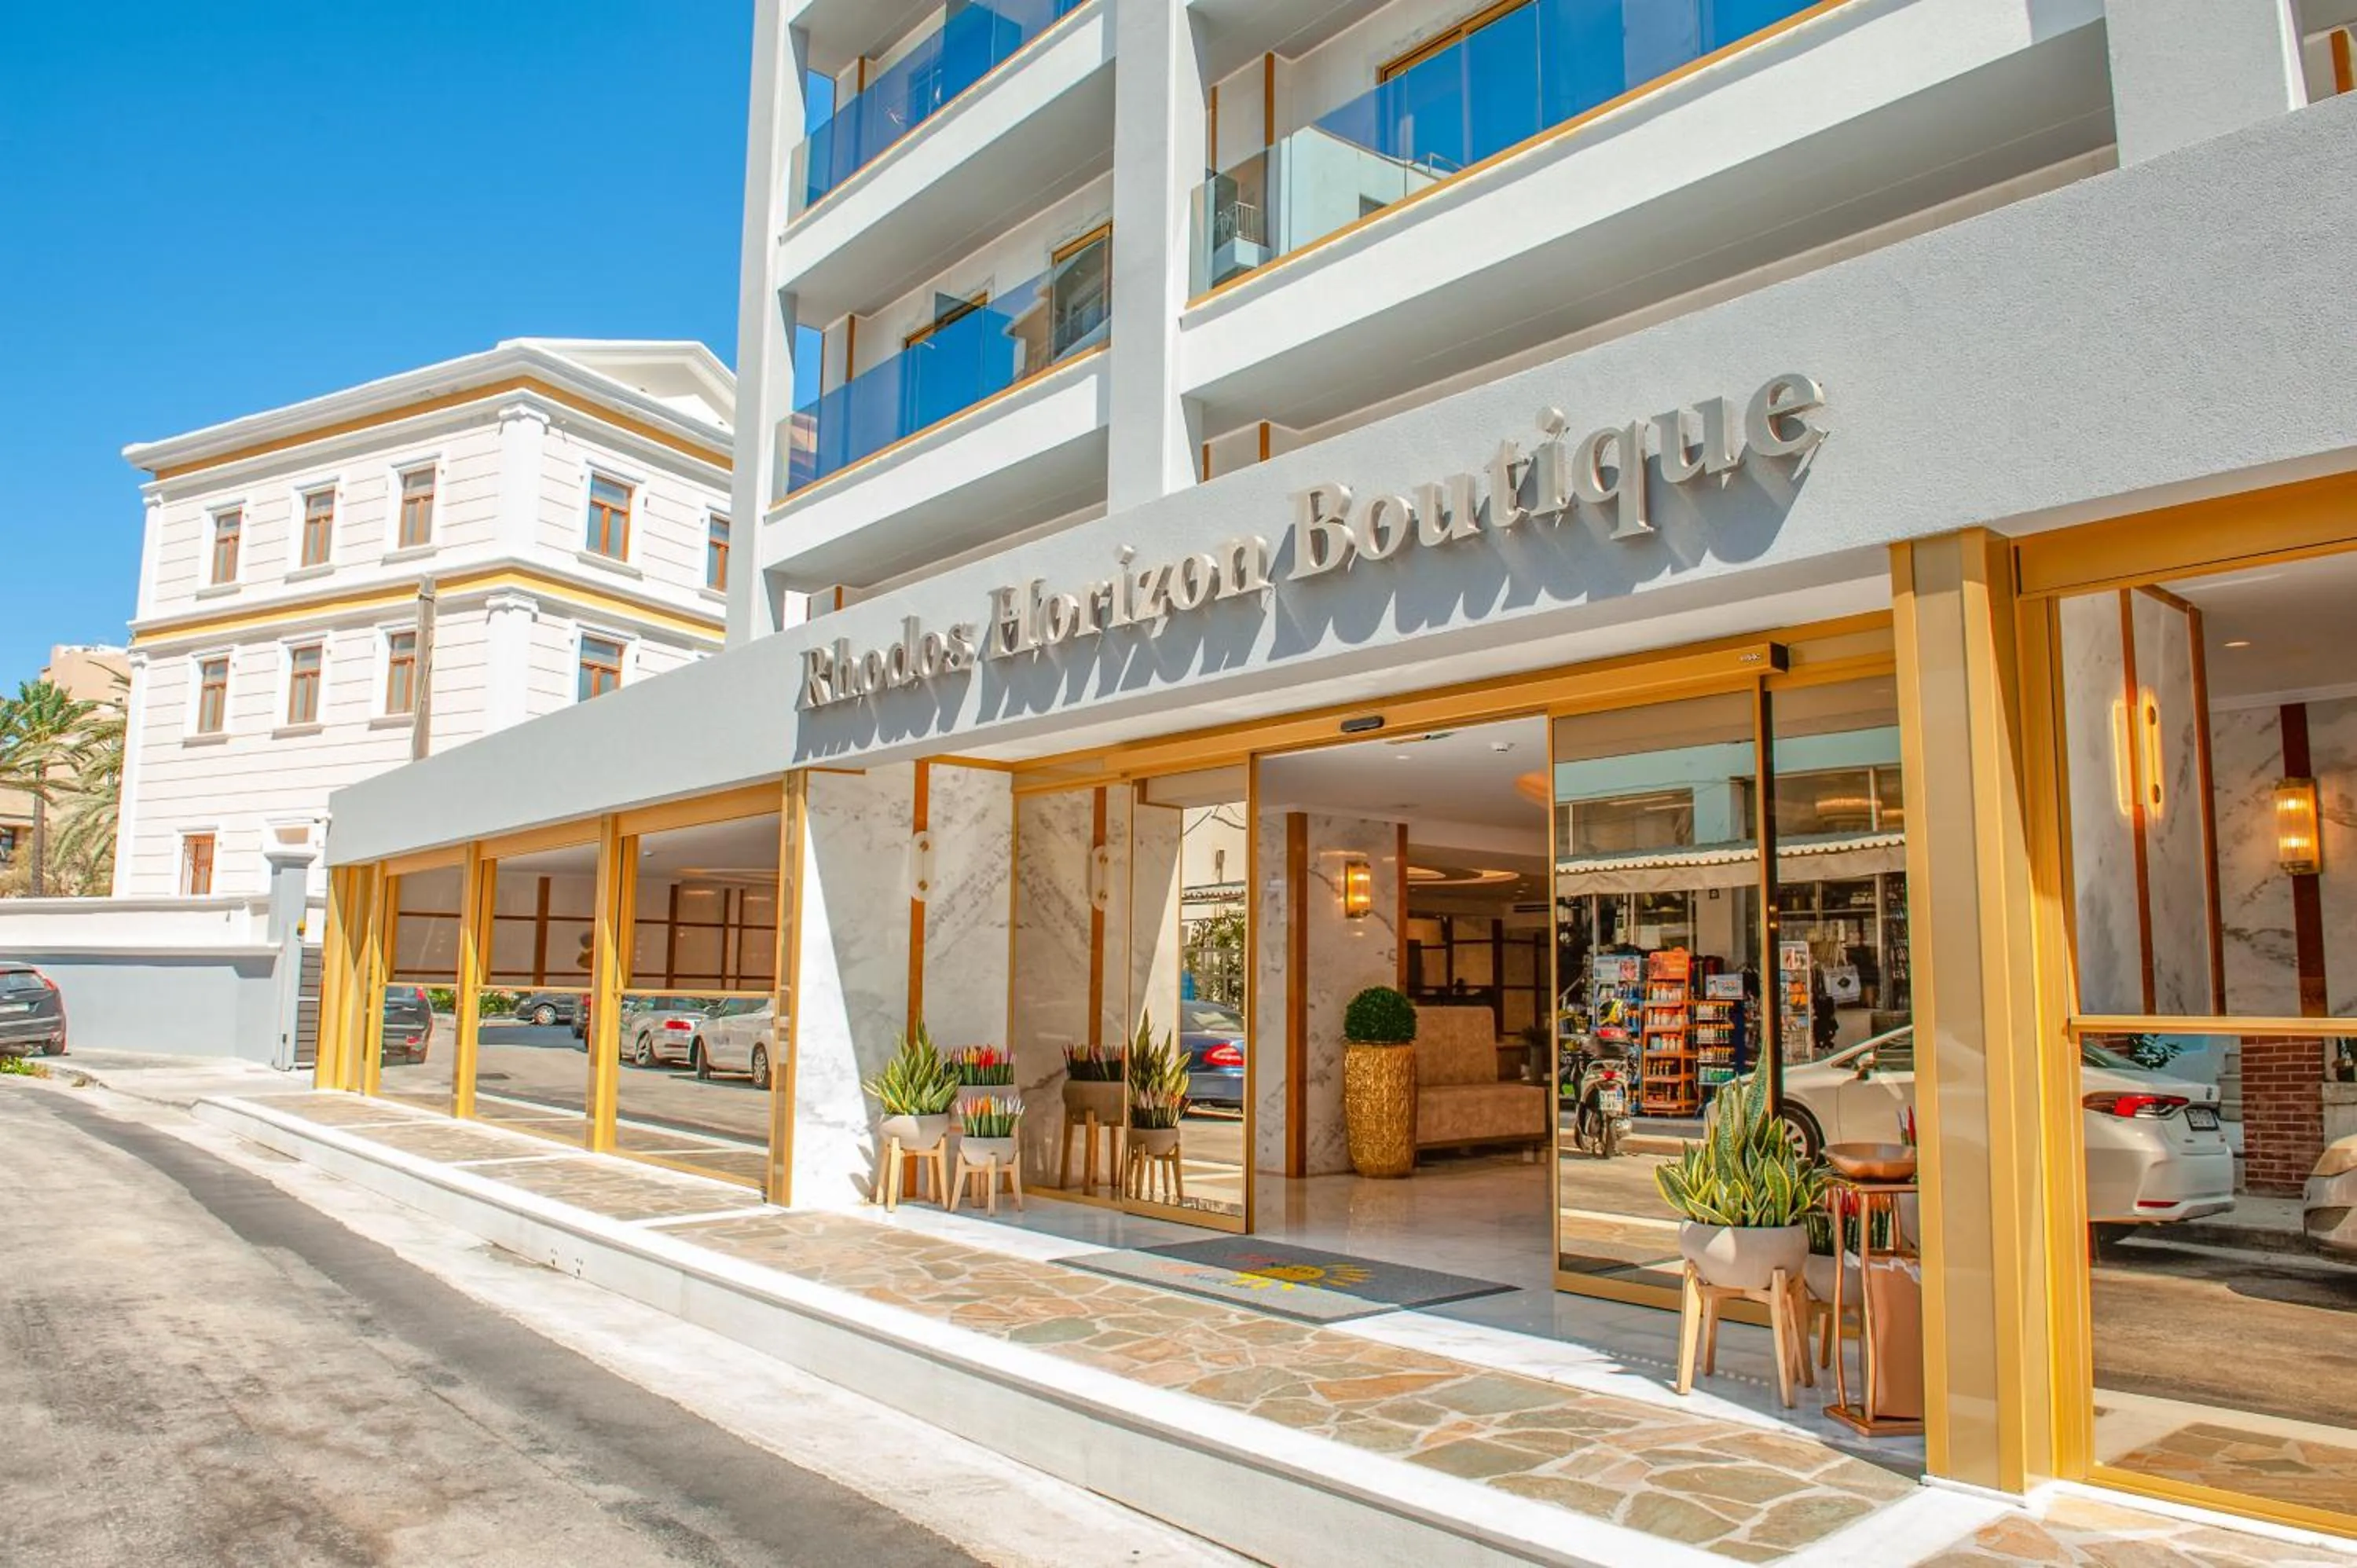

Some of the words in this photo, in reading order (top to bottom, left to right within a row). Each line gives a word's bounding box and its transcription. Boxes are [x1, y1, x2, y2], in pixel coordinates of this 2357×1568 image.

[801, 616, 976, 711] Rhodos
[988, 535, 1274, 661] Horizon
[1287, 372, 1827, 581] Boutique
